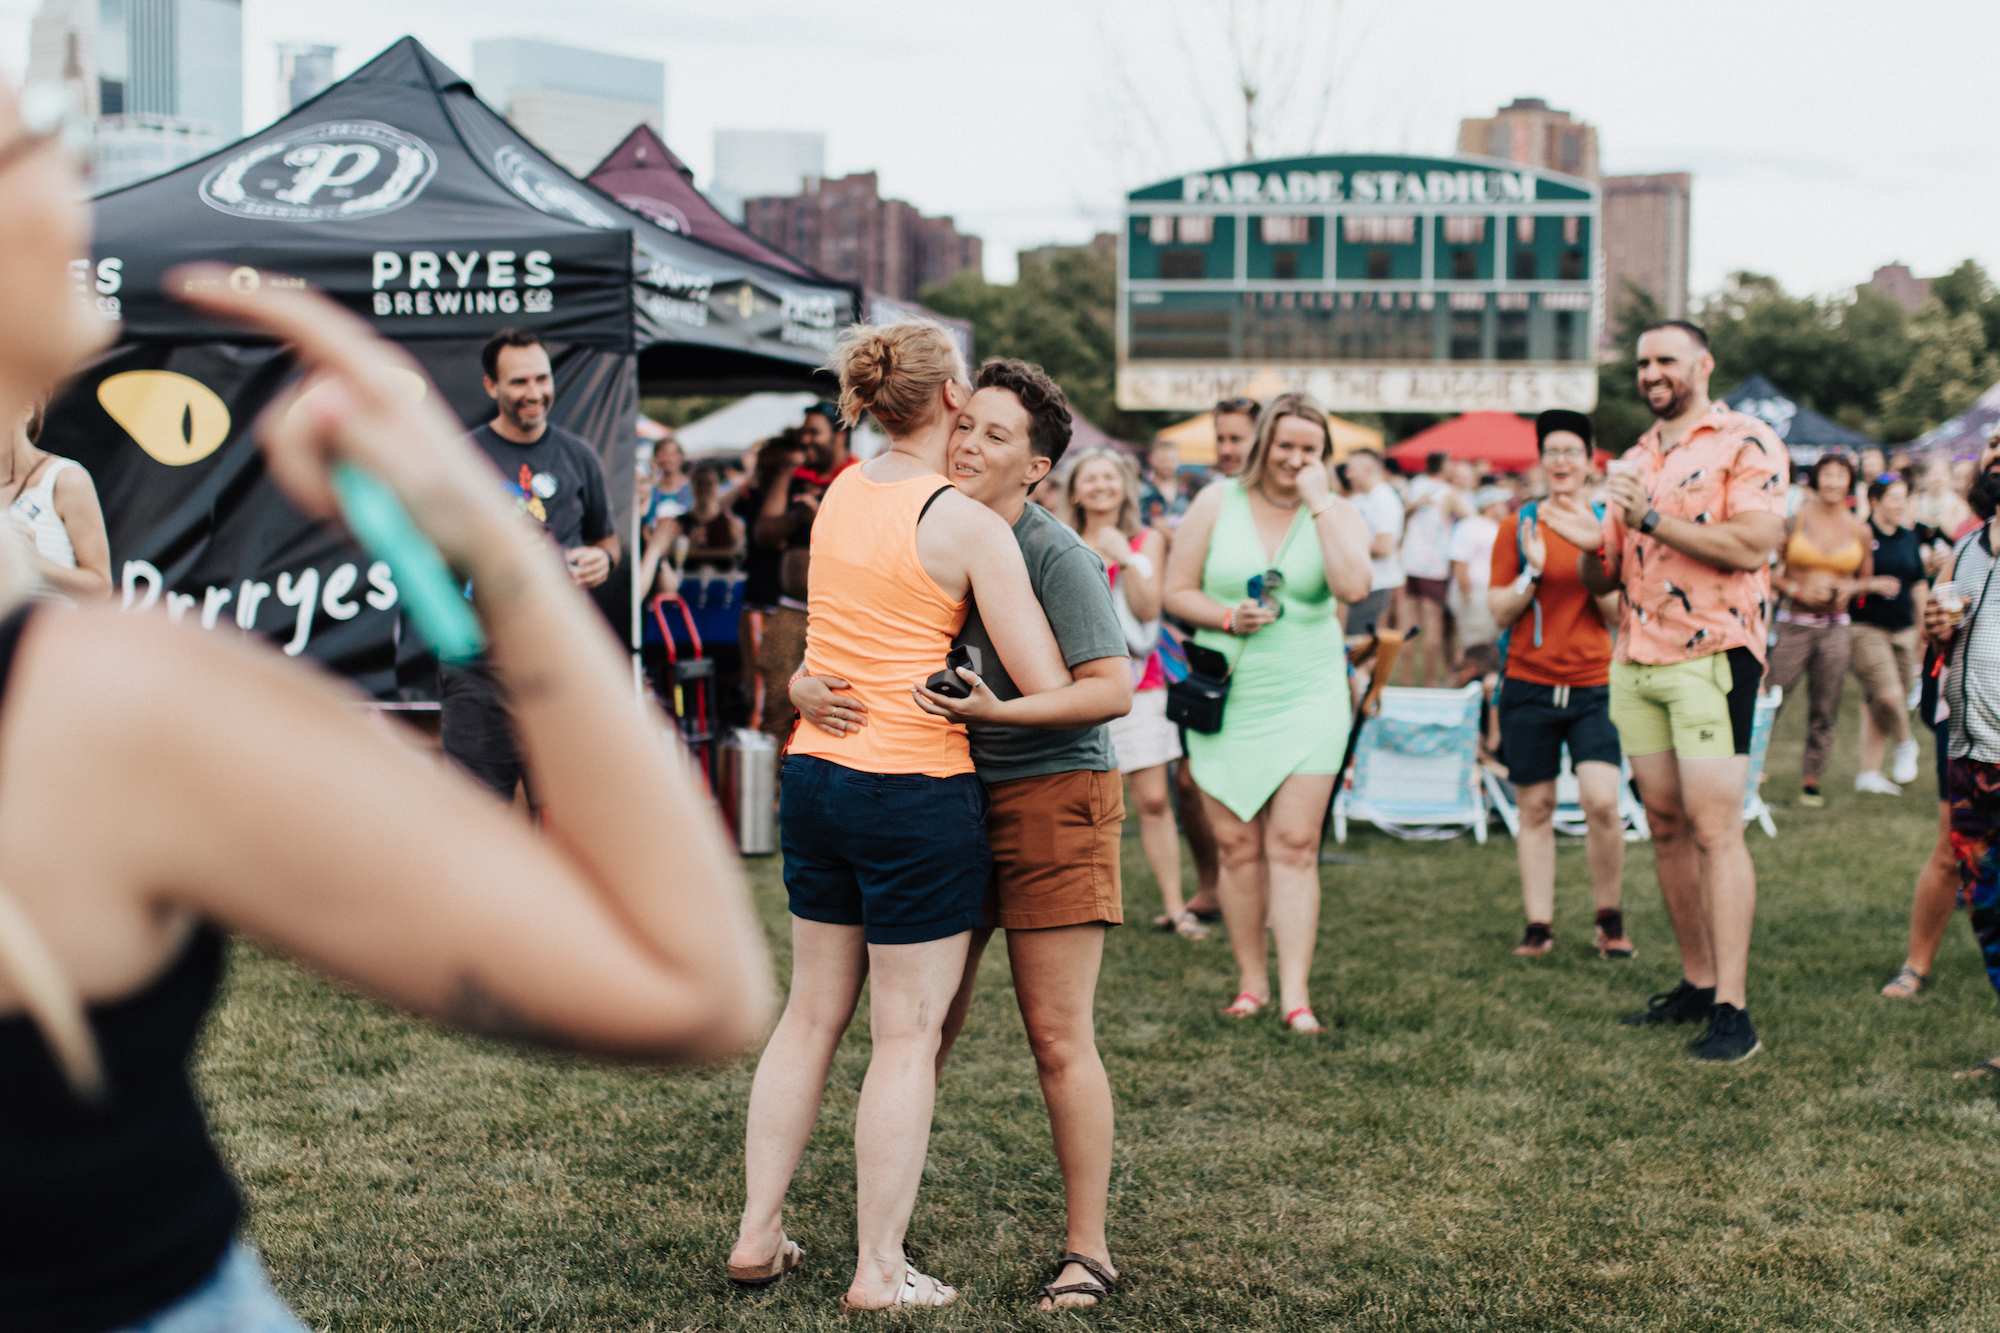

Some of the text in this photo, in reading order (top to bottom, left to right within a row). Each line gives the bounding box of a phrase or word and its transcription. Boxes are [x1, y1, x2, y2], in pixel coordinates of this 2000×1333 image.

[1182, 170, 1537, 202] PARADE STADIUM
[372, 250, 555, 290] PRYES
[373, 287, 554, 316] BREWING CO
